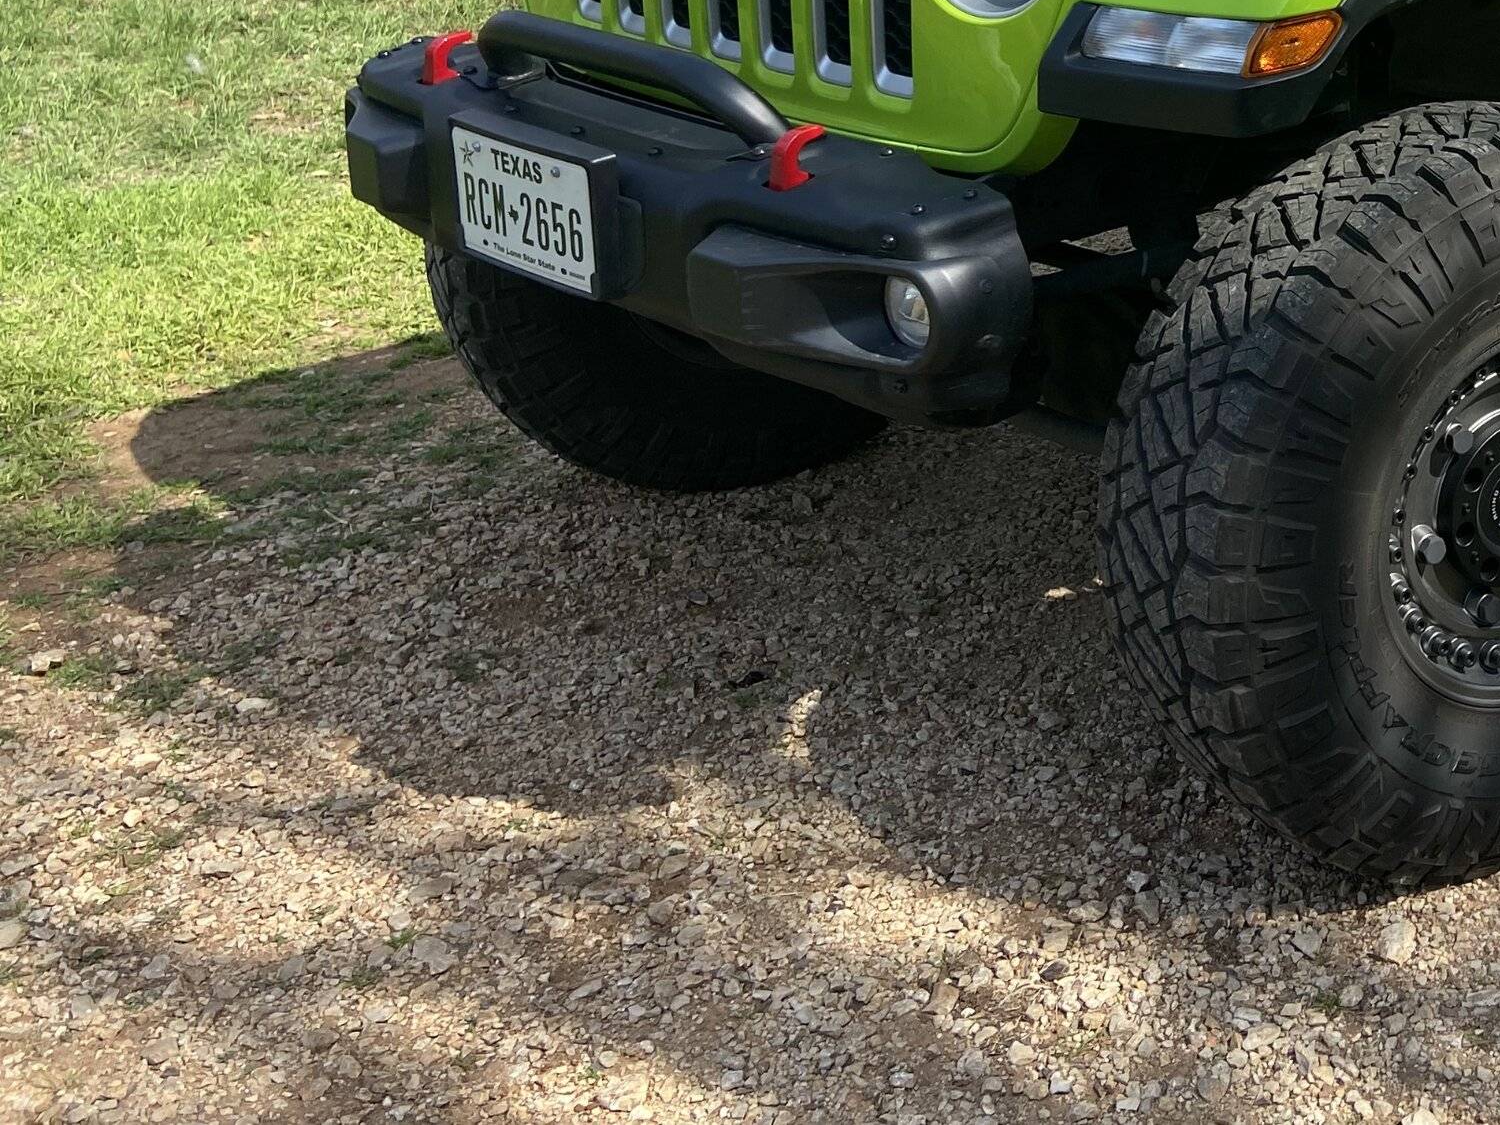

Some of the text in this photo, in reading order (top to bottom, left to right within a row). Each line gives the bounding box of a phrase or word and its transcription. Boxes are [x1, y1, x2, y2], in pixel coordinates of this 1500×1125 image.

[490, 148, 543, 184] TEXAS
[463, 172, 583, 263] RCM 2656
[493, 241, 556, 272] The Lone Star State
[1491, 489, 1499, 520] RHINO
